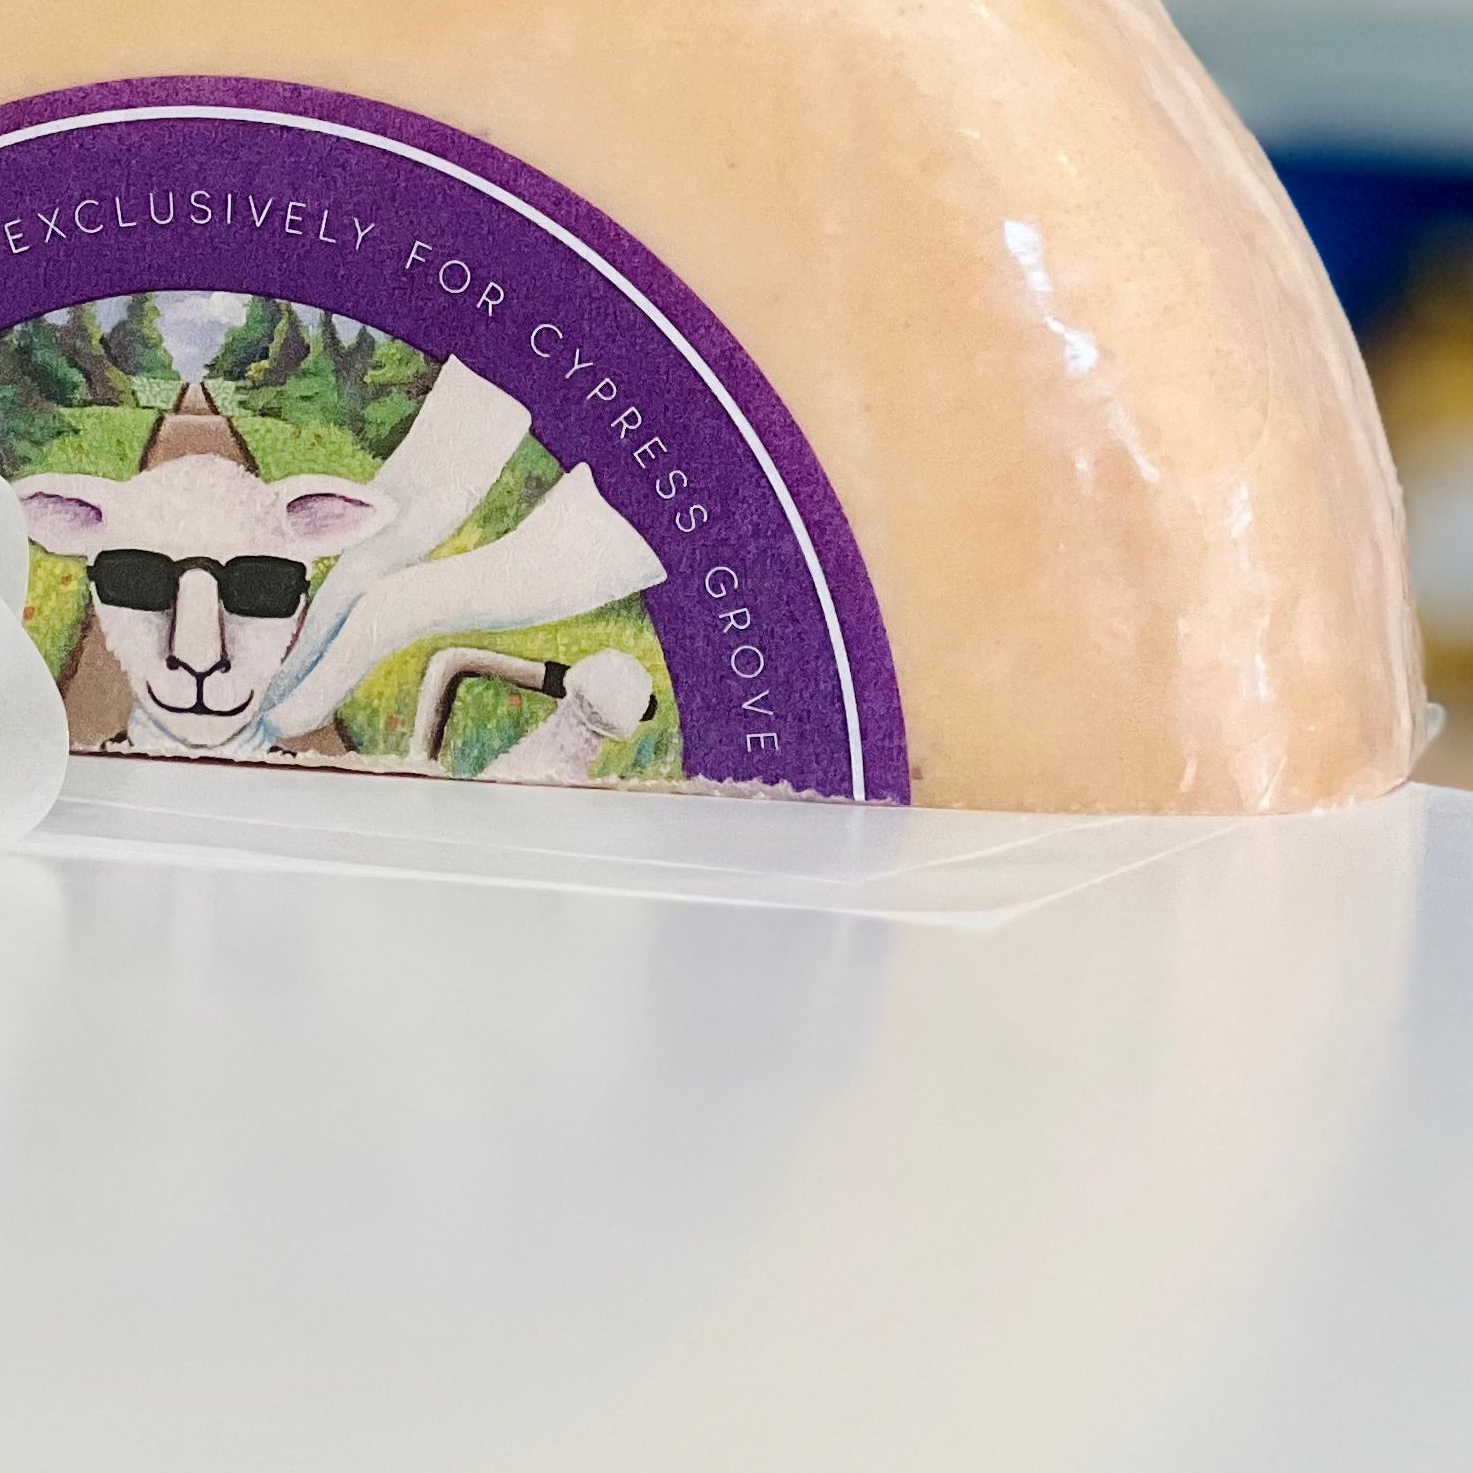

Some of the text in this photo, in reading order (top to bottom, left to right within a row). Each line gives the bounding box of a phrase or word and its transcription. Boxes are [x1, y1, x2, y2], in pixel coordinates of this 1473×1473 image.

[3, 190, 376, 254] EXCLUSIVELY
[404, 239, 506, 318] FOR
[529, 323, 709, 535] CYPRESS
[704, 565, 780, 754] GROVE
